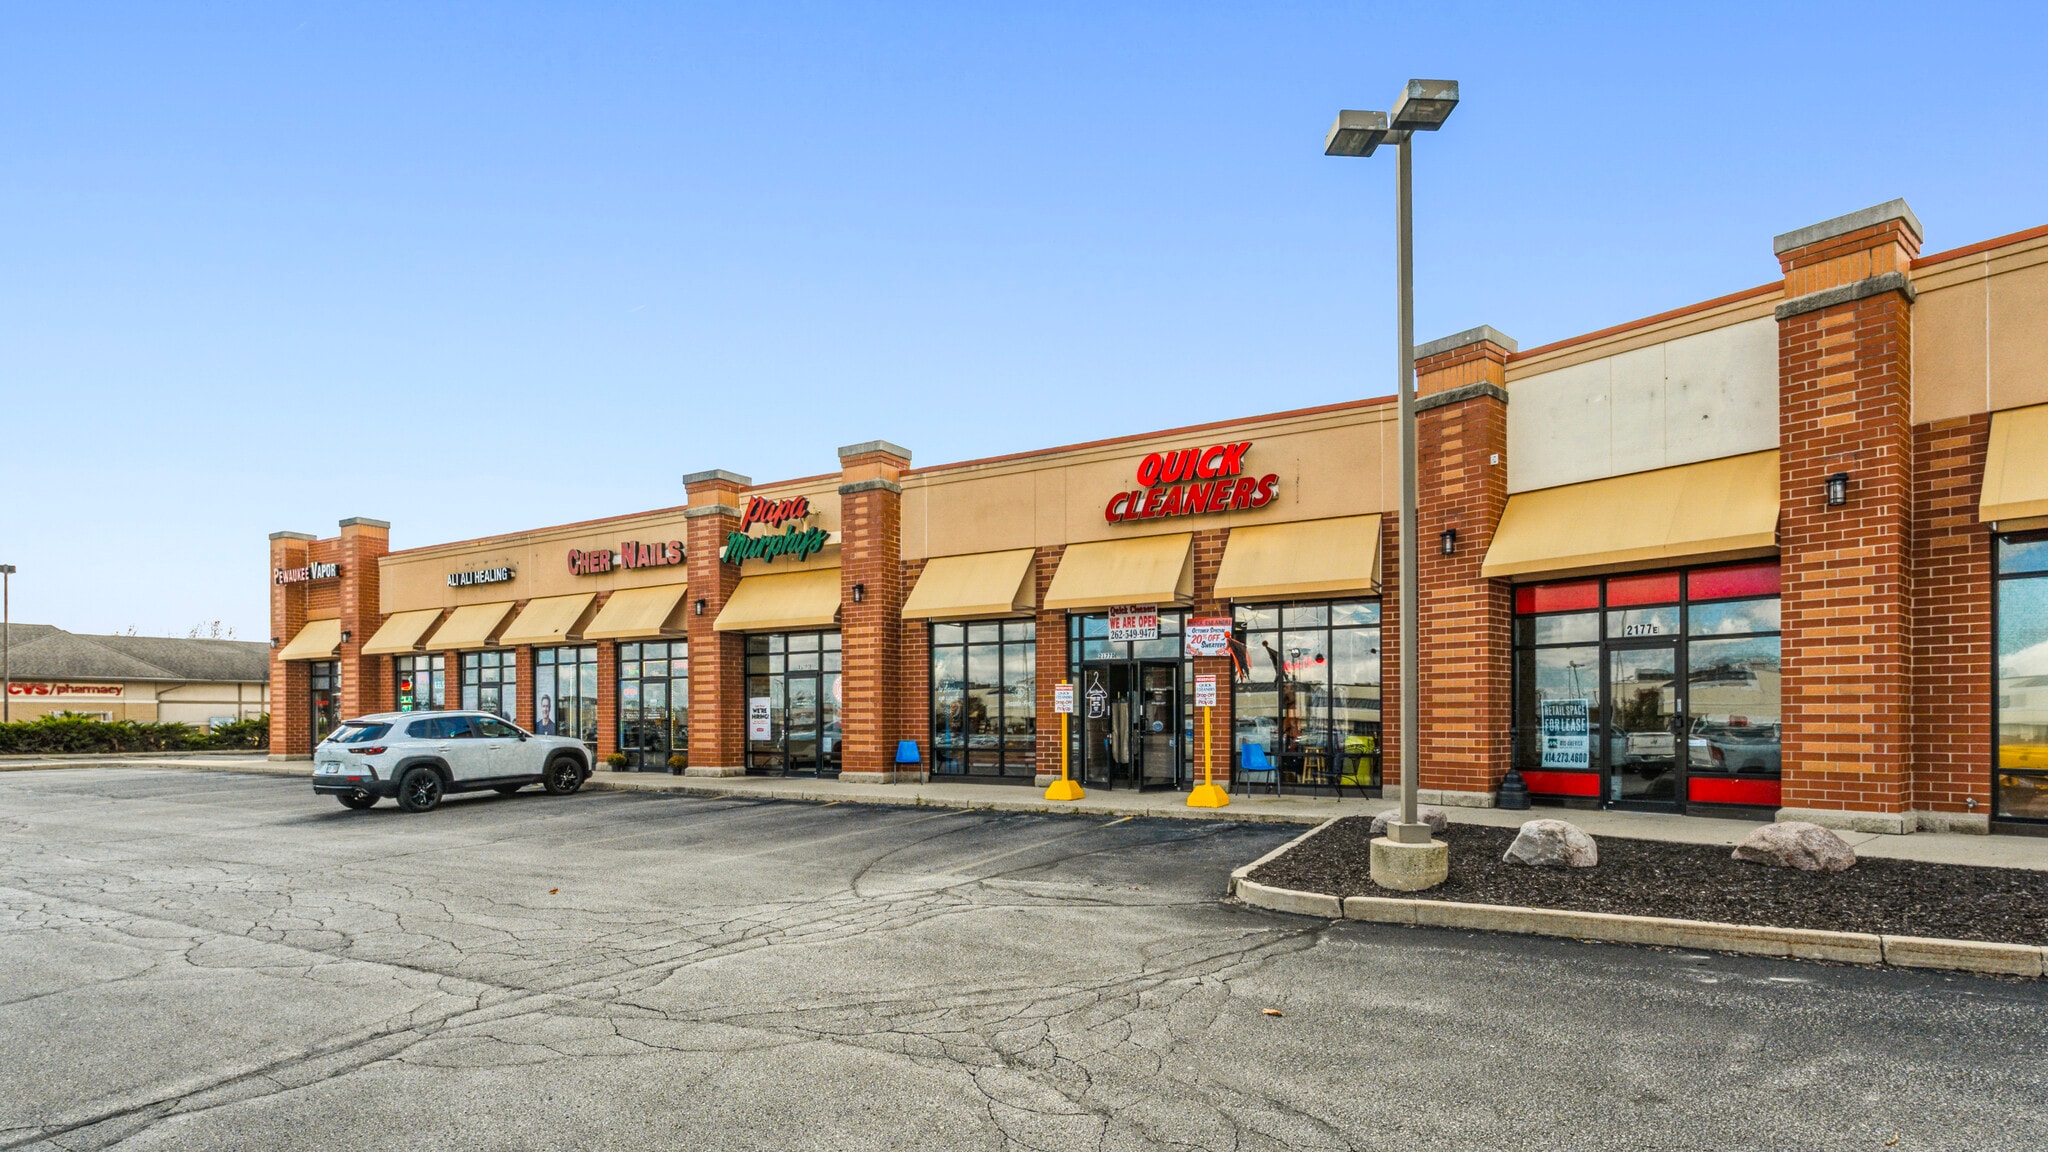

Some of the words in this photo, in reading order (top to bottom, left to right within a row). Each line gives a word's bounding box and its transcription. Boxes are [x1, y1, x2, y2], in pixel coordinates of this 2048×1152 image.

[1136, 441, 1252, 488] QUICK
[1104, 473, 1280, 523] CLEANERS
[740, 495, 808, 533] Papa
[723, 524, 828, 565] Murphy's
[567, 548, 611, 576] CHER
[621, 540, 682, 570] NAILS
[273, 567, 310, 585] PEWAUKEE
[311, 561, 338, 580] VAPOR
[447, 573, 459, 586] ALI
[460, 571, 473, 585] ALI
[474, 567, 508, 584] HEALING
[1110, 606, 1128, 617] Quick
[1130, 604, 1156, 614] Cleaners
[1110, 617, 1120, 629] WE
[1122, 616, 1136, 629] ARE
[1138, 615, 1157, 628] OPEN
[1110, 628, 1156, 640] 262-549-9477
[1626, 623, 1659, 636] 2177E
[1207, 633, 1221, 642] OFF
[8, 682, 123, 697] CVS/pharmacy
[1544, 705, 1565, 716] RETAIL
[1565, 705, 1586, 716] SPACE
[1544, 718, 1560, 731] FOR
[1561, 718, 1586, 732] LEASE
[1544, 752, 1587, 763] 414.273.4600
